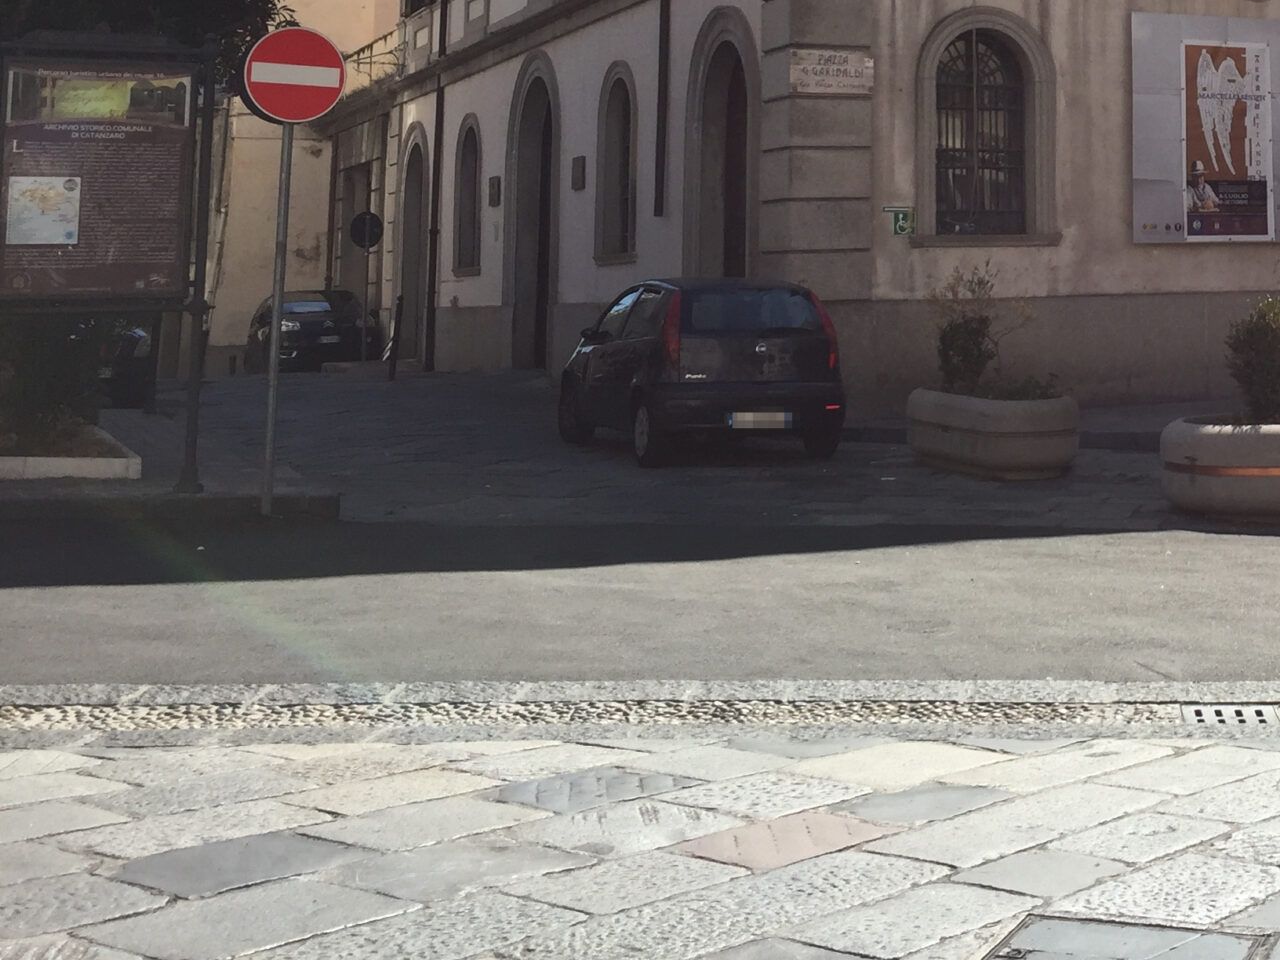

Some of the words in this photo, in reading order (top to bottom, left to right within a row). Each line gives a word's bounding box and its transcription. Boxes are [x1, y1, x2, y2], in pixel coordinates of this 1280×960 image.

[817, 54, 849, 66] PIAZZA
[43, 123, 78, 132] ARCHIVIO
[80, 124, 112, 132] STORICO
[113, 124, 153, 133] COMUNALE
[80, 131, 126, 139] CATANZARO
